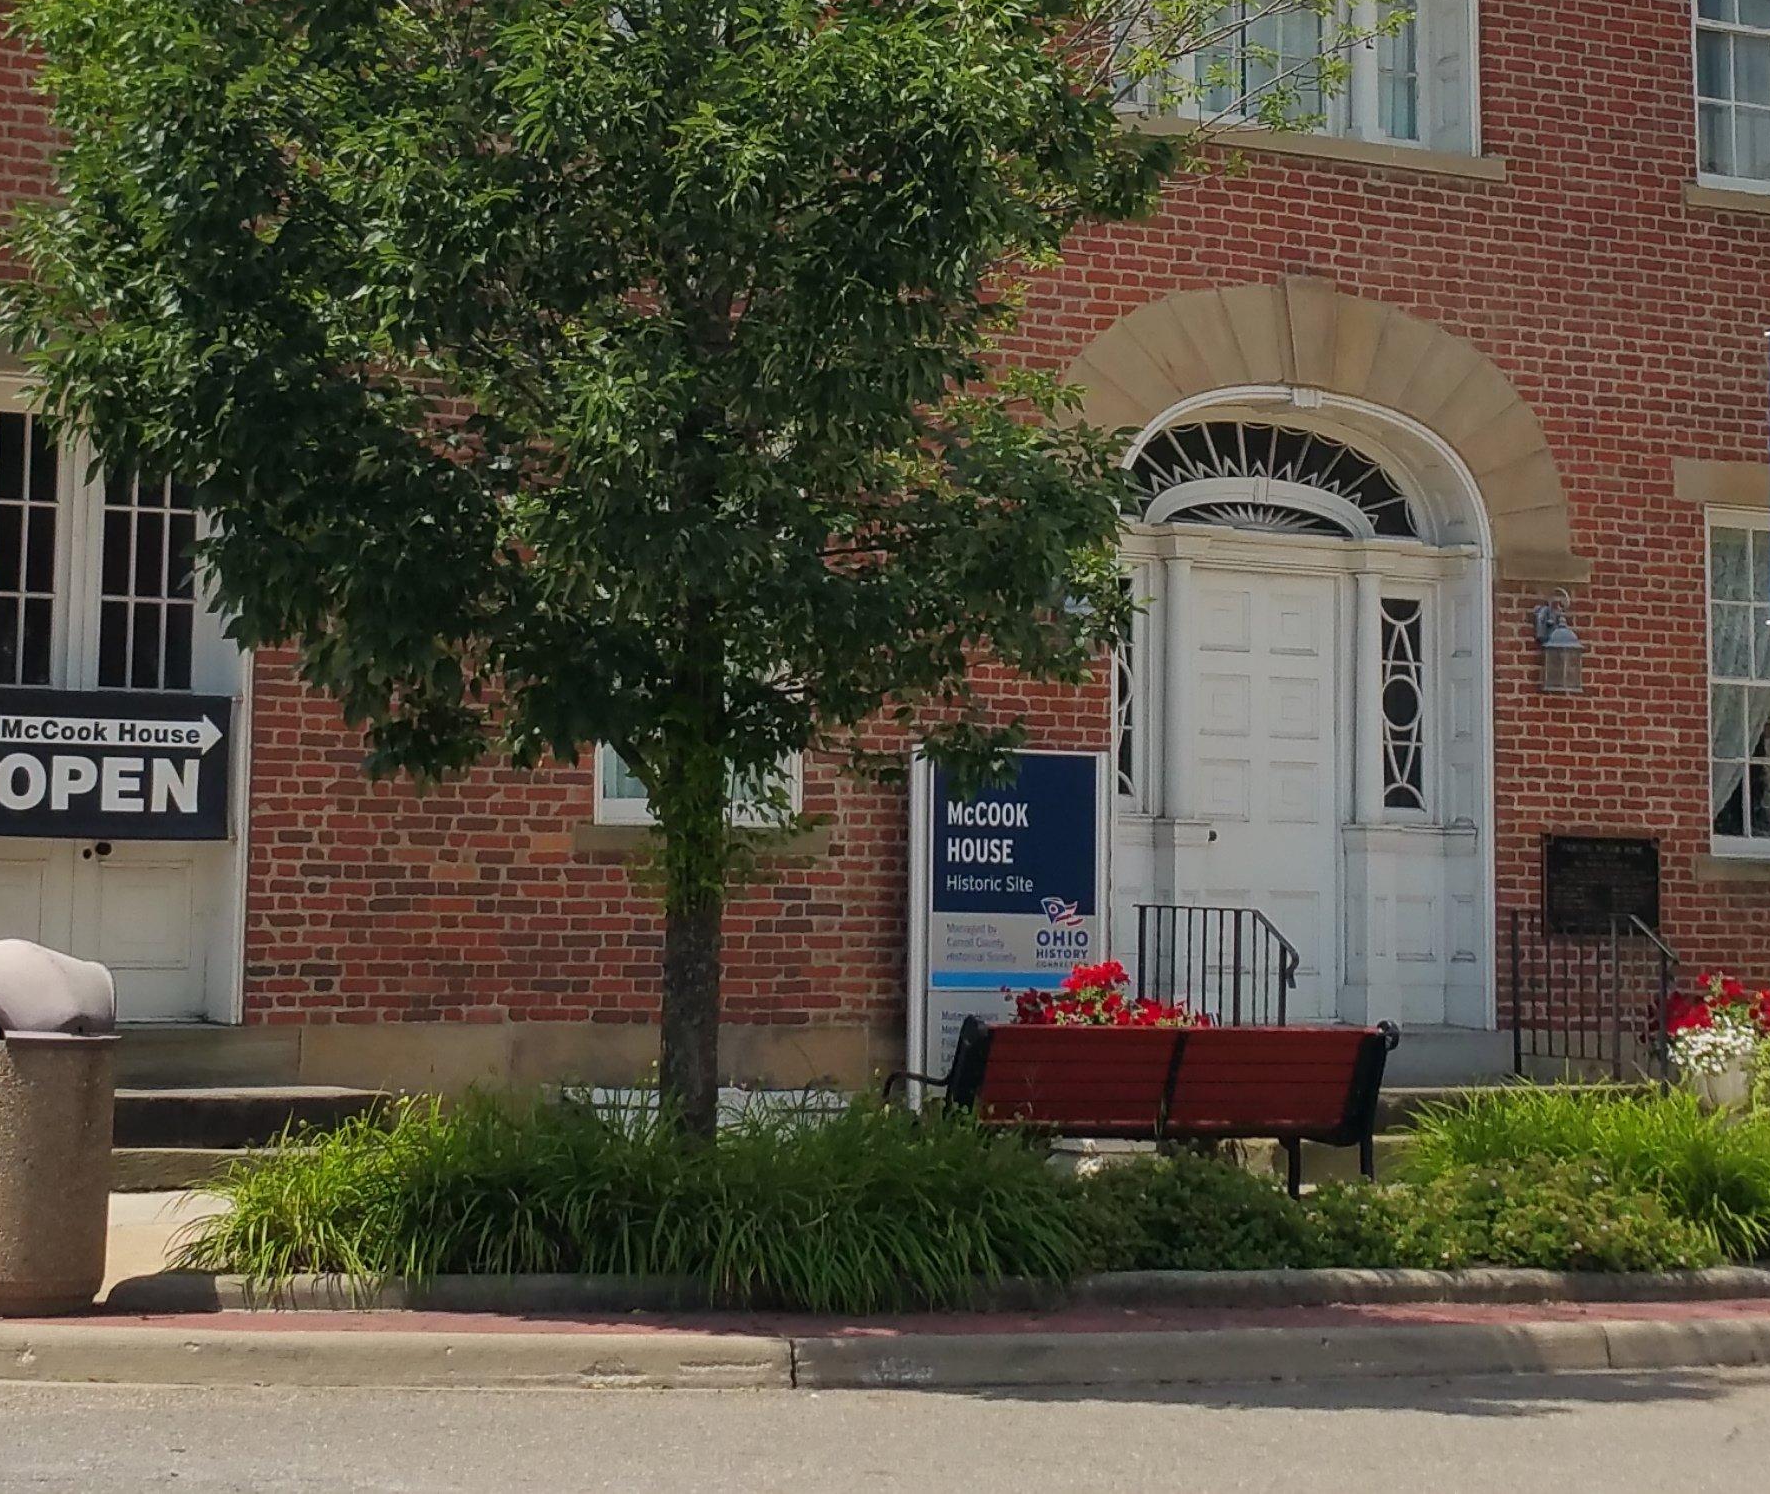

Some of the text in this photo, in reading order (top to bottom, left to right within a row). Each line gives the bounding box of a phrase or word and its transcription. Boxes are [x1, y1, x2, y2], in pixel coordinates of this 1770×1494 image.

[1, 718, 201, 745] McCook House
[947, 801, 1029, 827] McCOOK
[947, 837, 1014, 863] HOUSE
[947, 874, 1034, 892] Historic Site
[1036, 930, 1088, 947] OHIO
[1036, 948, 1088, 959] HISTORY
